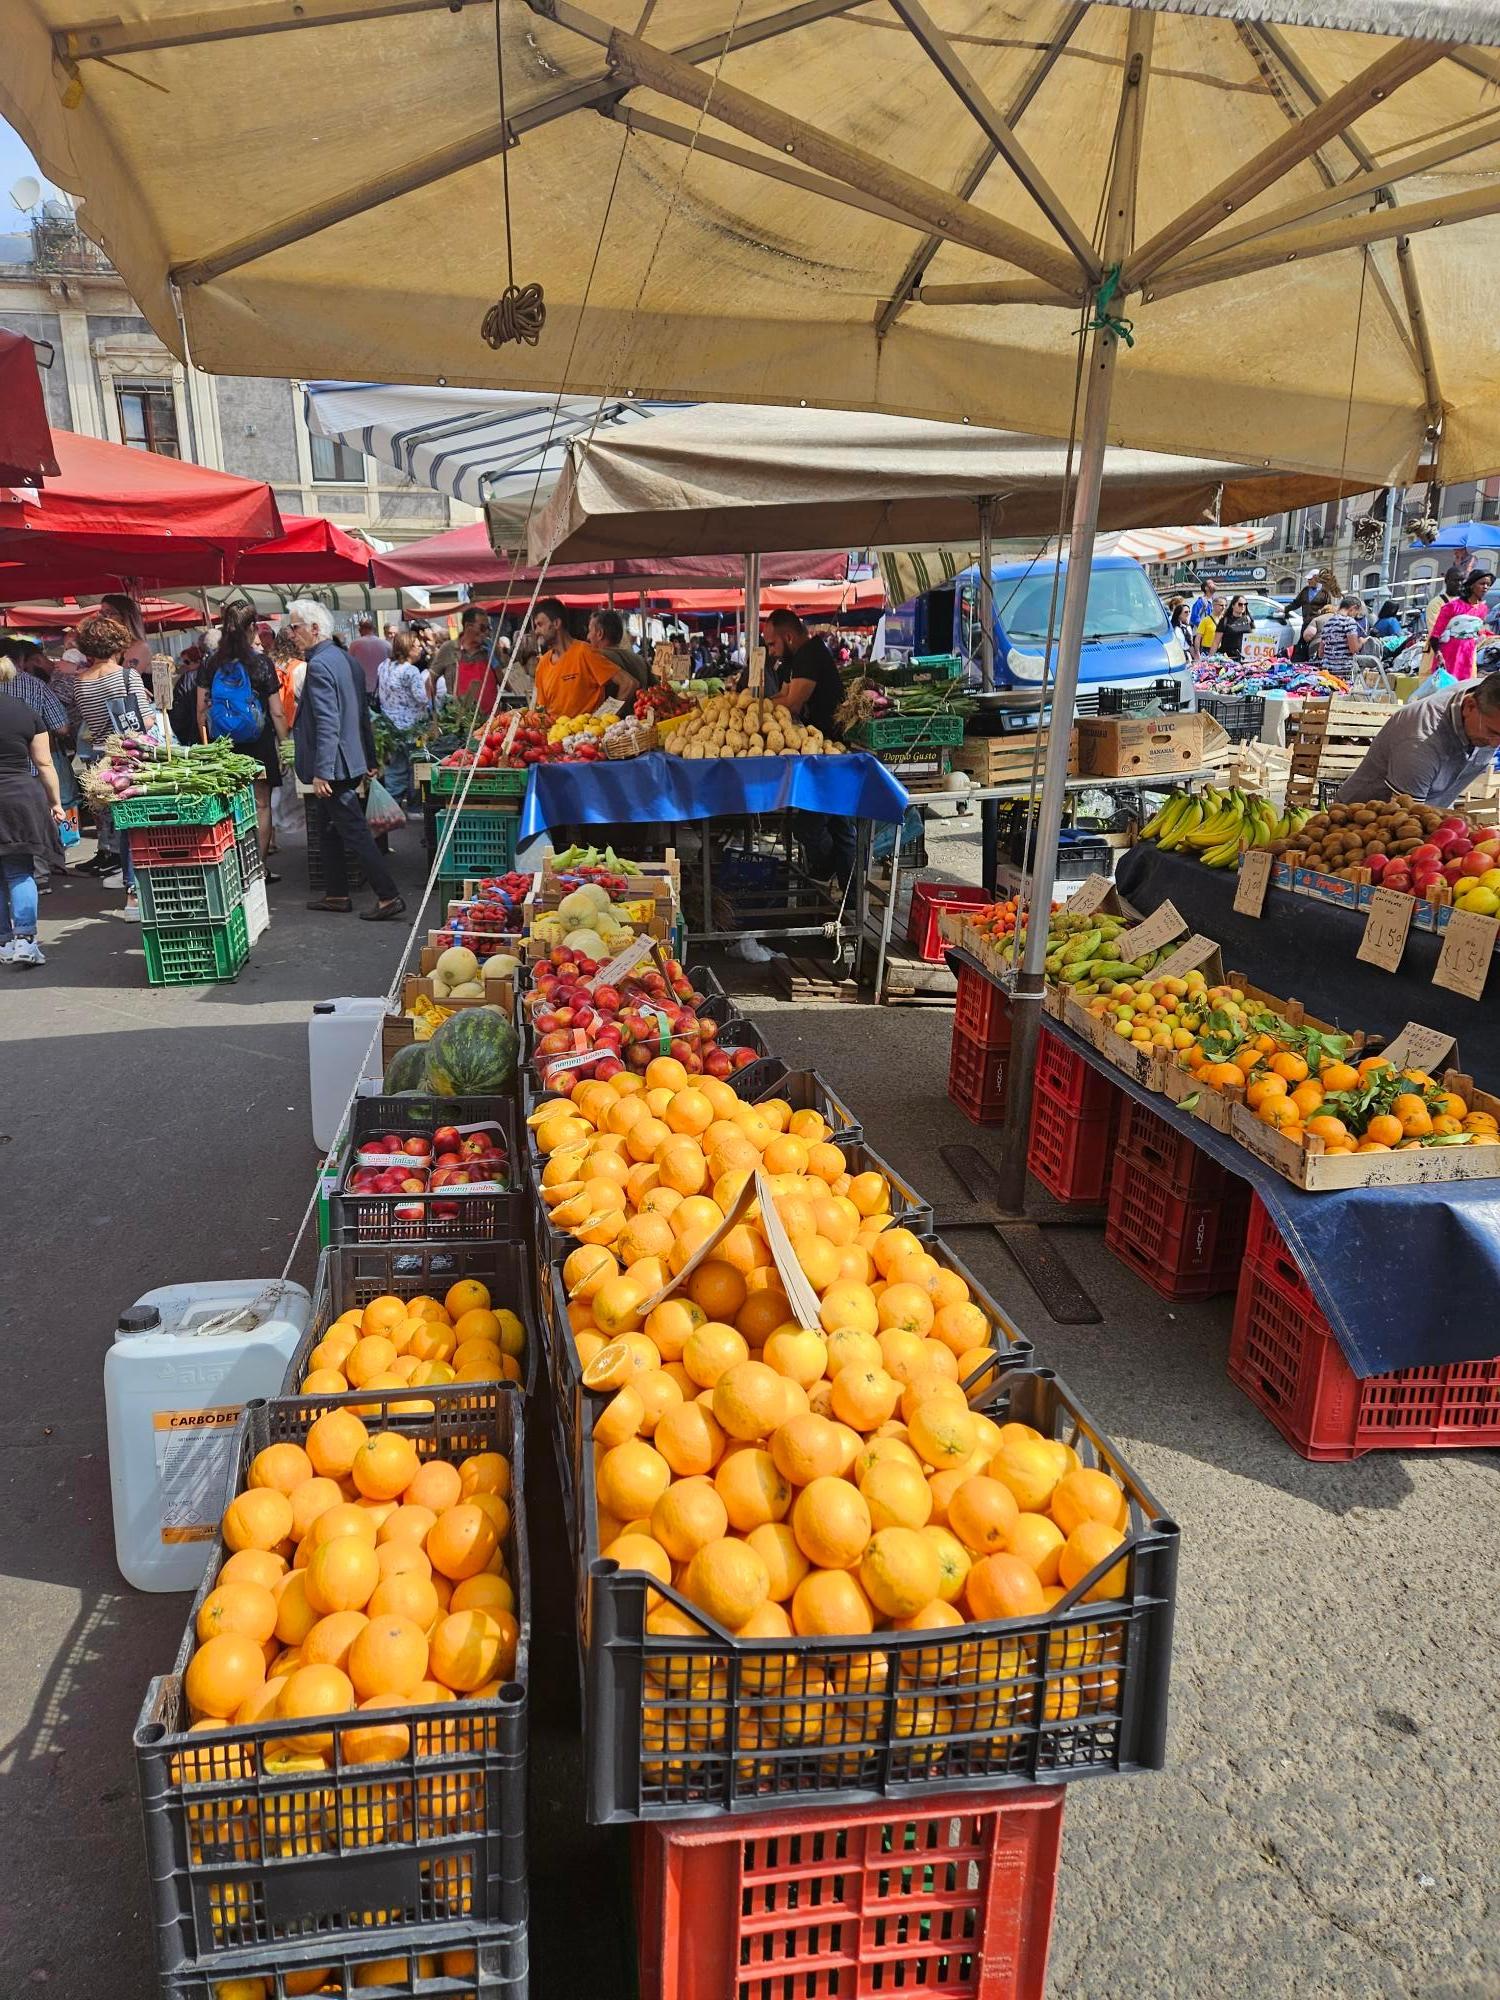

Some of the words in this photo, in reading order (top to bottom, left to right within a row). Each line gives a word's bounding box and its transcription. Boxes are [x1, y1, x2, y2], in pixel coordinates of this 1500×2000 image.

[1157, 723, 1176, 733] UTC
[912, 751, 937, 763] Gusto
[170, 1412, 241, 1427] CARBODET
